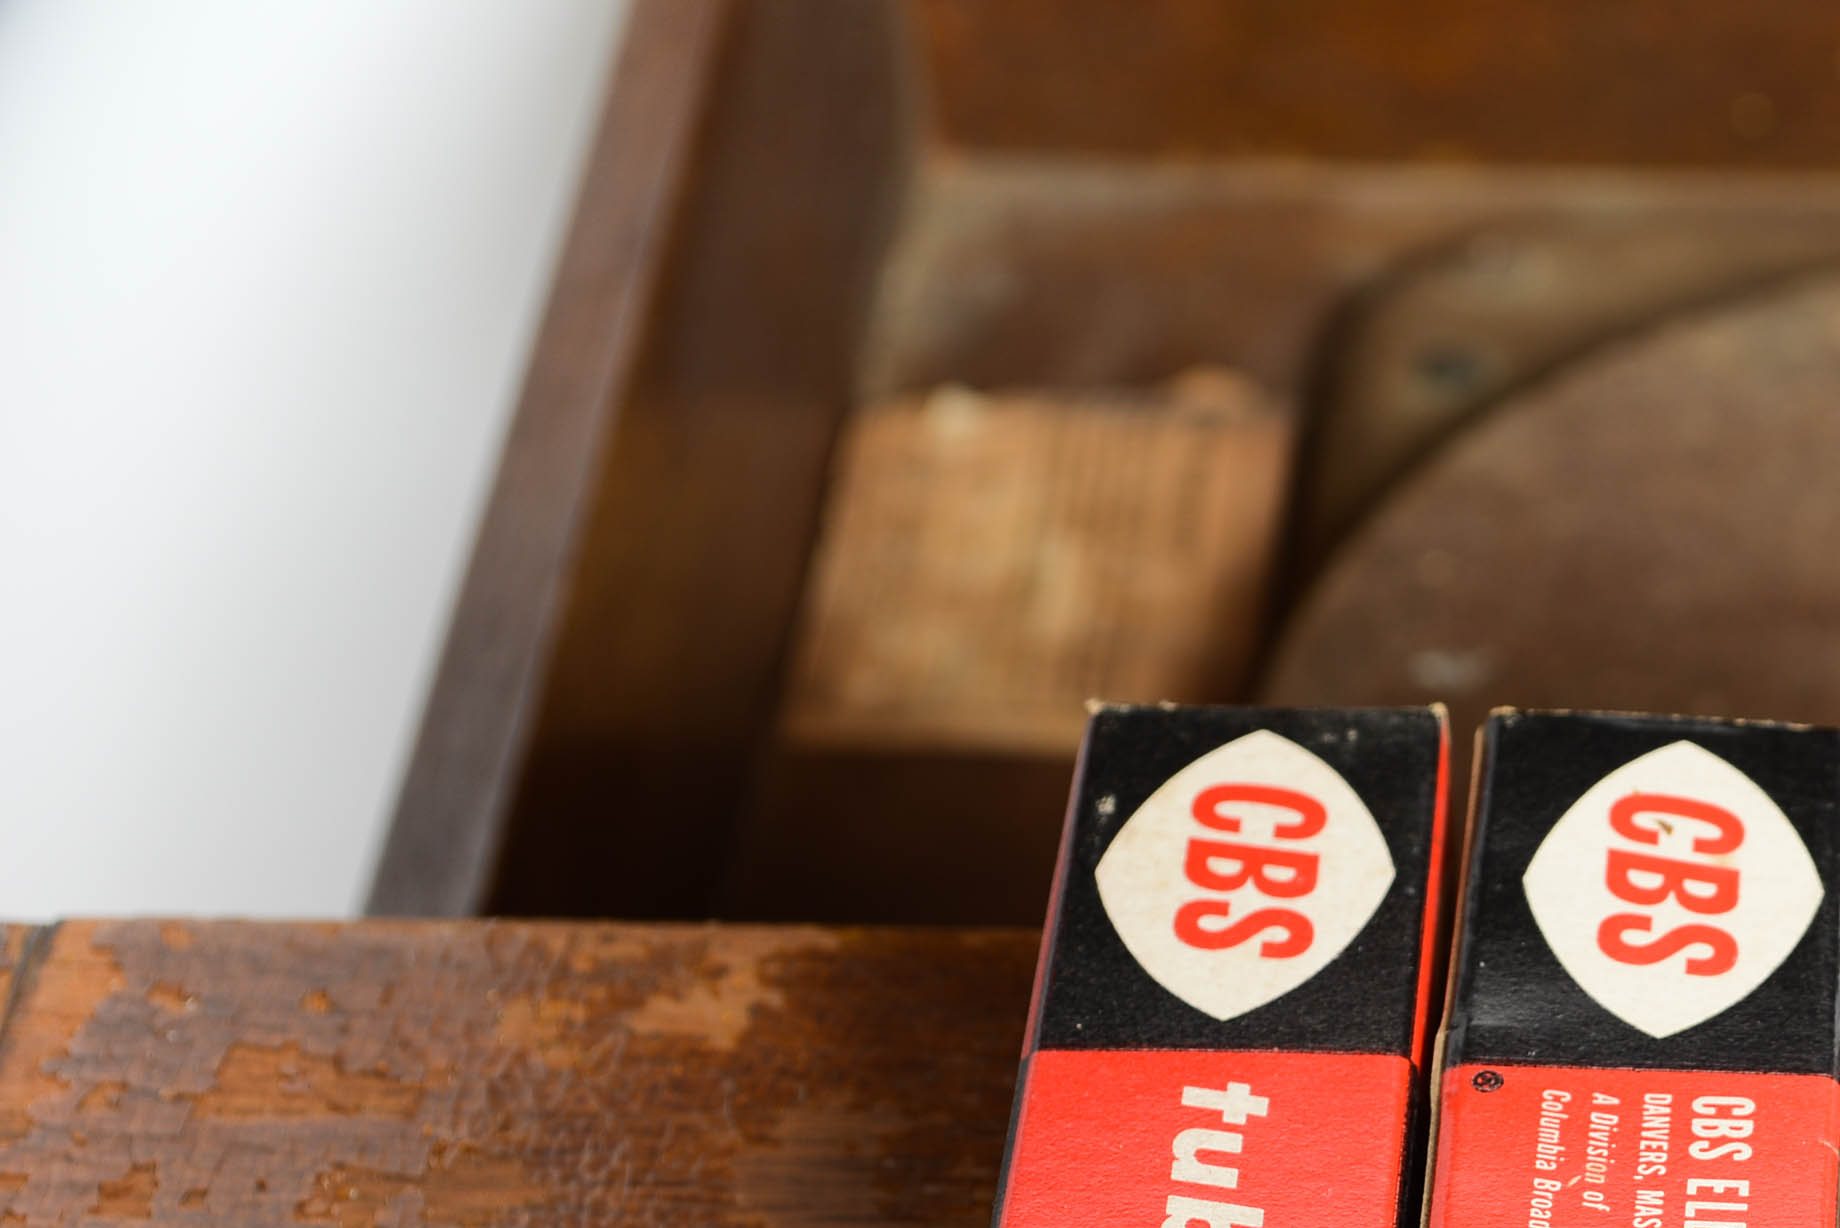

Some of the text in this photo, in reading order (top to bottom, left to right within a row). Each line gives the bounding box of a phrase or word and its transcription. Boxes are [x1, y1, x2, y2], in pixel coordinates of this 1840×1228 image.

[1173, 782, 1327, 959] CBS
[1596, 790, 1745, 977] CBS
[1534, 1088, 1573, 1171] Columbia
[1581, 1091, 1620, 1213] A Division of
[1632, 1092, 1673, 1181] DANVERS,
[1688, 1095, 1756, 1162] CBS
